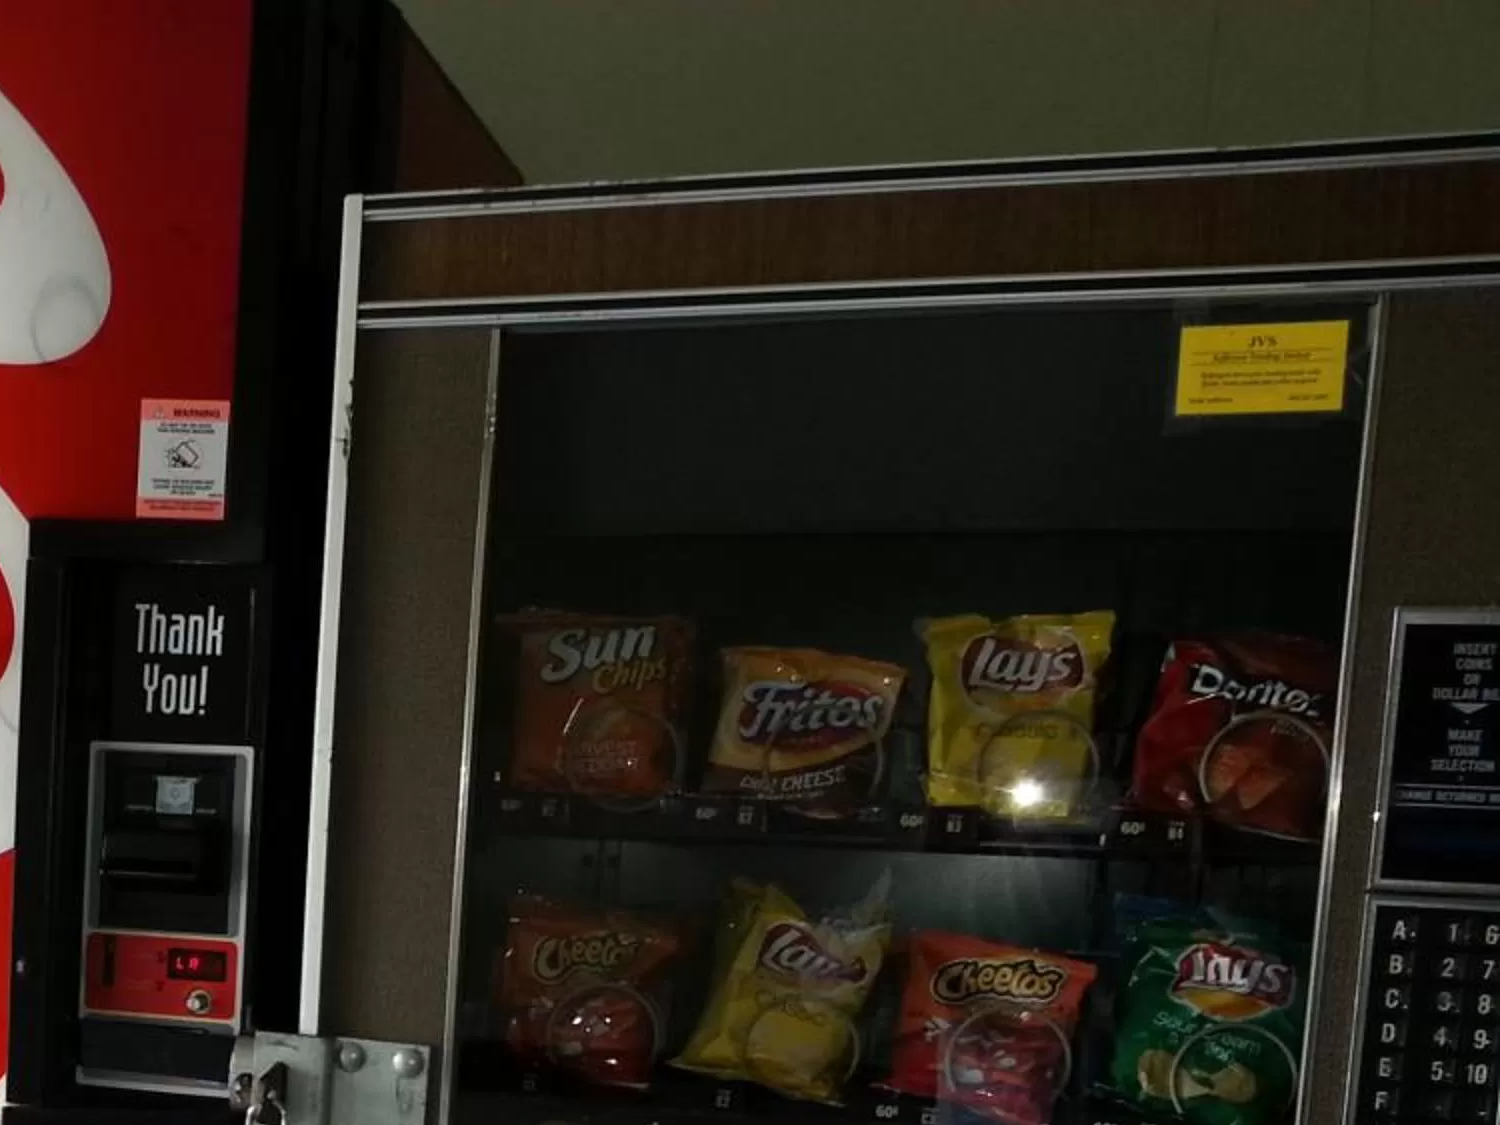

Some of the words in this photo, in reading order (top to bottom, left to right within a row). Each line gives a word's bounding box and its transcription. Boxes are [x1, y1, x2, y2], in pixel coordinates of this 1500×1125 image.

[135, 602, 225, 656] Thank
[540, 624, 657, 684] Sun
[142, 662, 210, 716] You!
[592, 660, 670, 694] Chips
[737, 680, 885, 738] Fritos
[1430, 759, 1496, 772] SELECTION
[1392, 920, 1407, 940] A
[1449, 924, 1460, 943] 1
[1485, 925, 1499, 945] 6
[1389, 954, 1403, 974] B
[1441, 958, 1455, 977] 2
[1483, 960, 1496, 979] 7
[934, 960, 1063, 1003] Cheetos
[1385, 988, 1400, 1008] C
[1437, 992, 1452, 1011] 3
[1477, 994, 1492, 1014] 8
[1381, 1023, 1396, 1043] D
[1433, 1026, 1447, 1046] 4
[1473, 1029, 1488, 1049] 9
[1379, 1057, 1392, 1077] E
[1431, 1061, 1444, 1081] 5
[1467, 1063, 1487, 1084] 10
[1375, 1091, 1388, 1111] F
